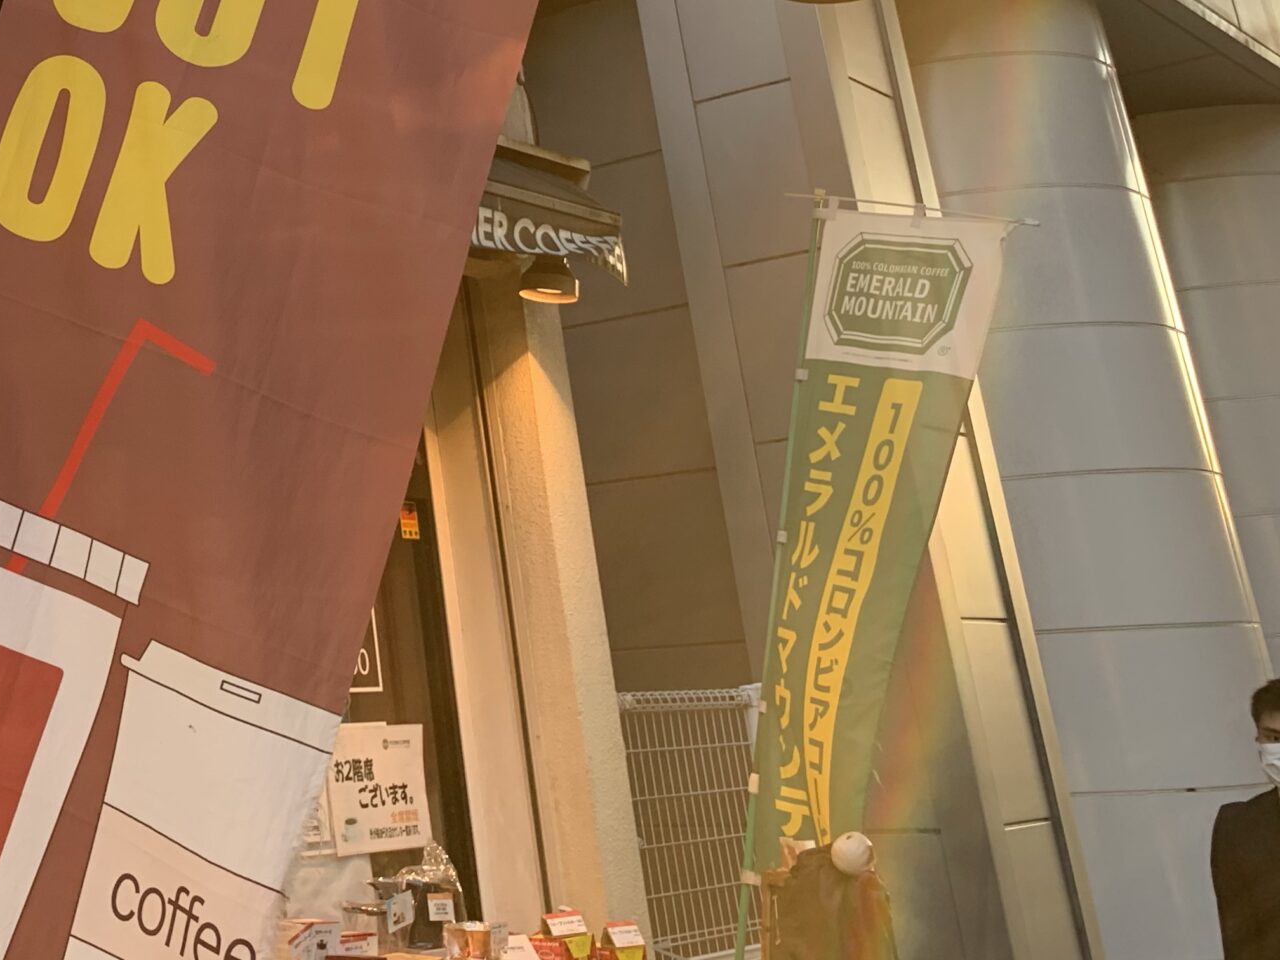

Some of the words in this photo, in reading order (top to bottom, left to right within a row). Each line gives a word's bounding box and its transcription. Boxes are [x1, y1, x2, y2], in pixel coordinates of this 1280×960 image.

[846, 273, 931, 299] EMERALD
[840, 295, 938, 323] MOUNTAIN
[334, 758, 375, 783] お2階席
[358, 783, 414, 809] ございます。
